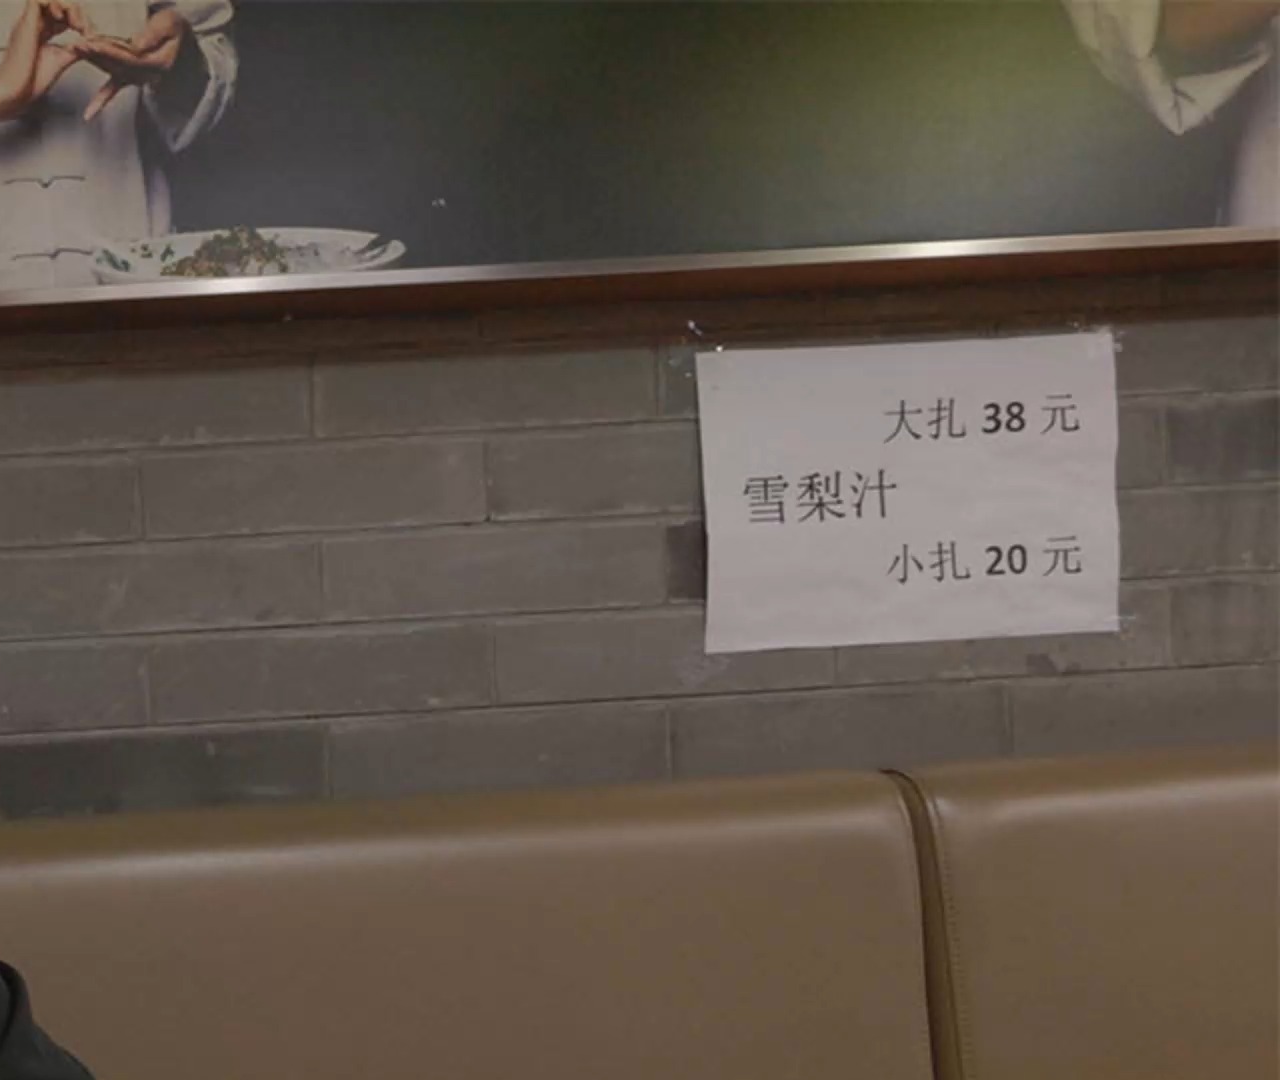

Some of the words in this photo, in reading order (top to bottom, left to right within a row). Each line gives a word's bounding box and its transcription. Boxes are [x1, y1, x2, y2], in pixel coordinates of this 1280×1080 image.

[883, 397, 966, 444] 大扎
[981, 401, 1026, 434] 38
[1040, 394, 1080, 434] 元
[743, 468, 897, 524] 雪梨汁
[887, 541, 971, 584] 小扎
[985, 544, 1028, 576] 20
[1043, 536, 1083, 577] 元
